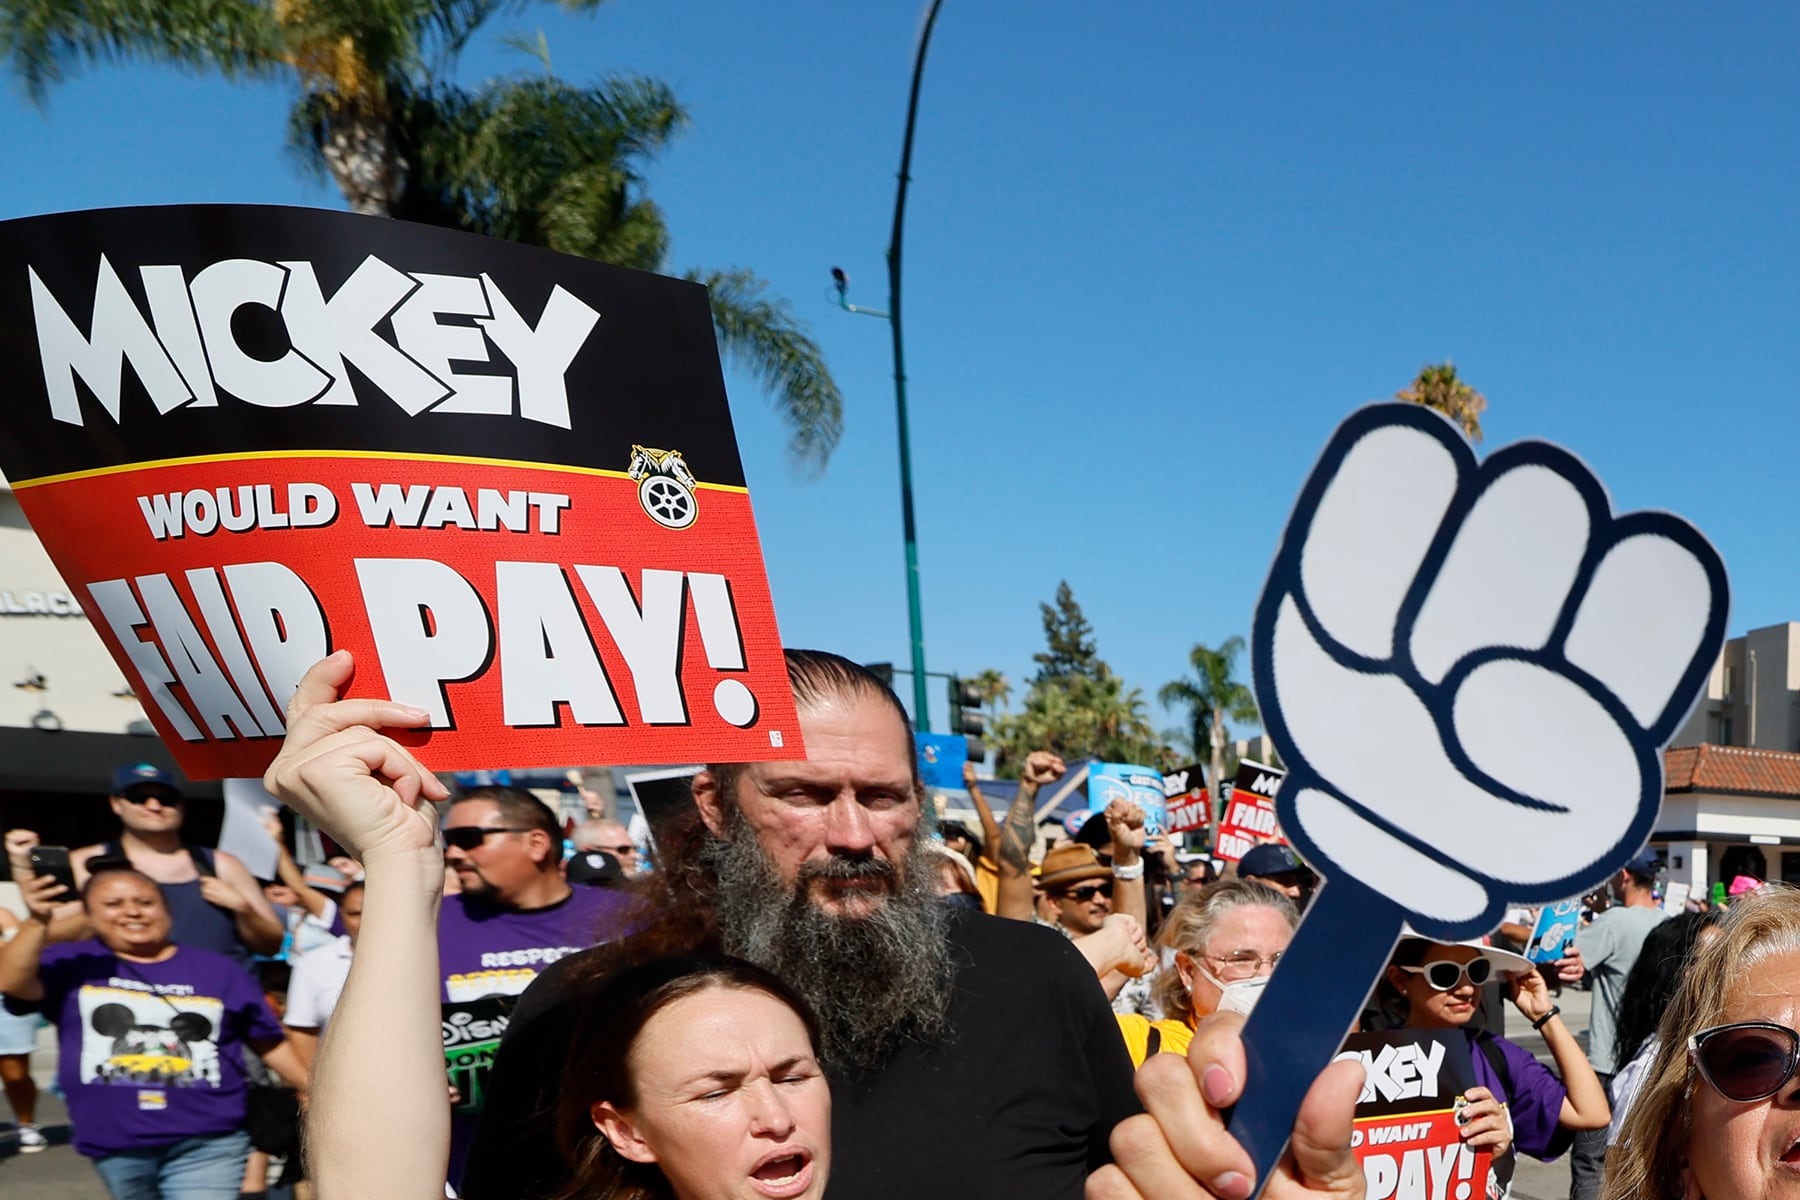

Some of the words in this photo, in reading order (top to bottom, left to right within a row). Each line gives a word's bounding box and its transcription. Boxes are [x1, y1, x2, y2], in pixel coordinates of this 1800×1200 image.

[29, 252, 600, 429] MICKEY
[138, 483, 336, 540] WOULD
[351, 483, 569, 534] WANT
[354, 558, 757, 730] PAY!
[1333, 1039, 1446, 1104] KEY
[1368, 1122, 1432, 1146] WANT
